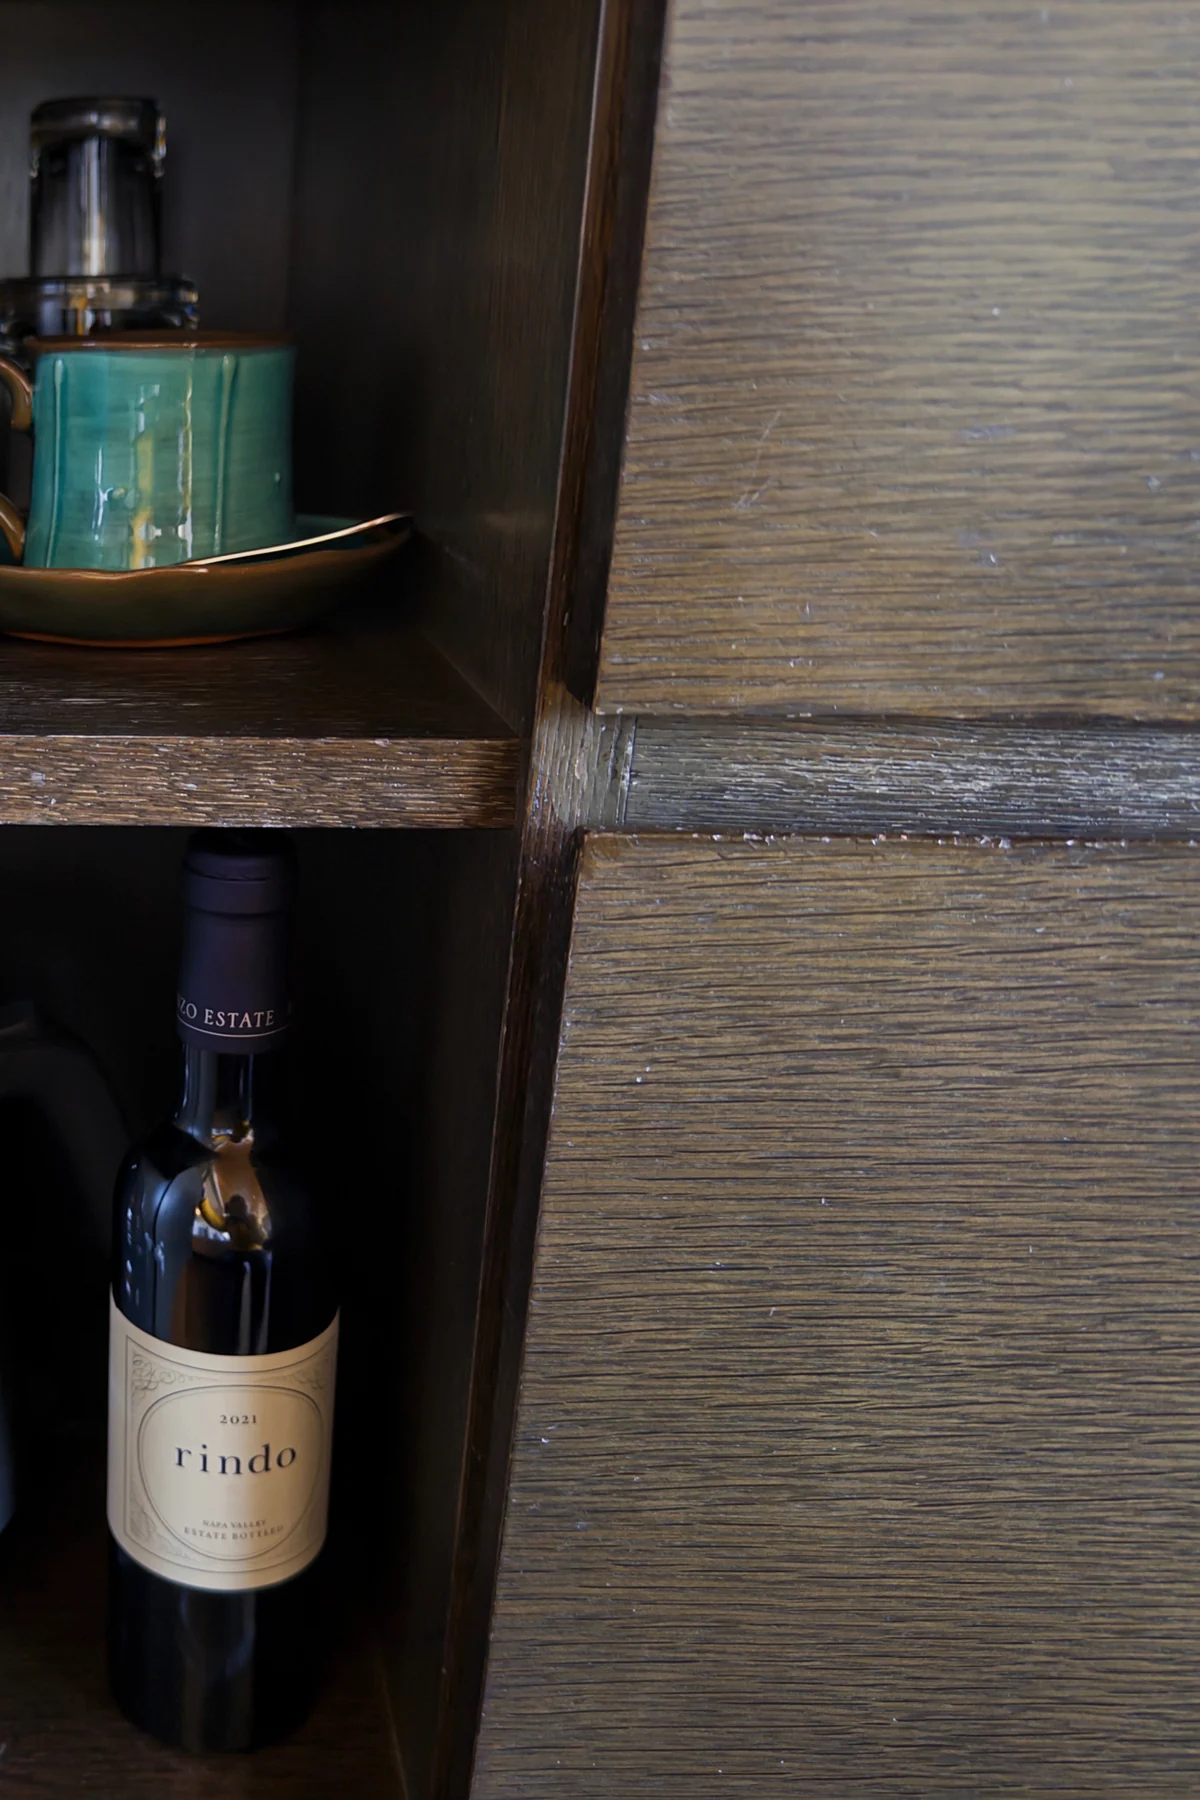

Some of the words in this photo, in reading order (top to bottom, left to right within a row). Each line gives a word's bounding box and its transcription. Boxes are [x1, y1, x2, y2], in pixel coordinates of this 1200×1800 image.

[203, 1008, 275, 1028] ESTATE
[219, 1414, 257, 1425] 2021
[175, 1443, 297, 1476] rindo
[202, 1519, 228, 1529] NAPA
[230, 1519, 266, 1529] VALLEY
[184, 1526, 227, 1540] ESTATE
[231, 1525, 284, 1540] BOTTLED
